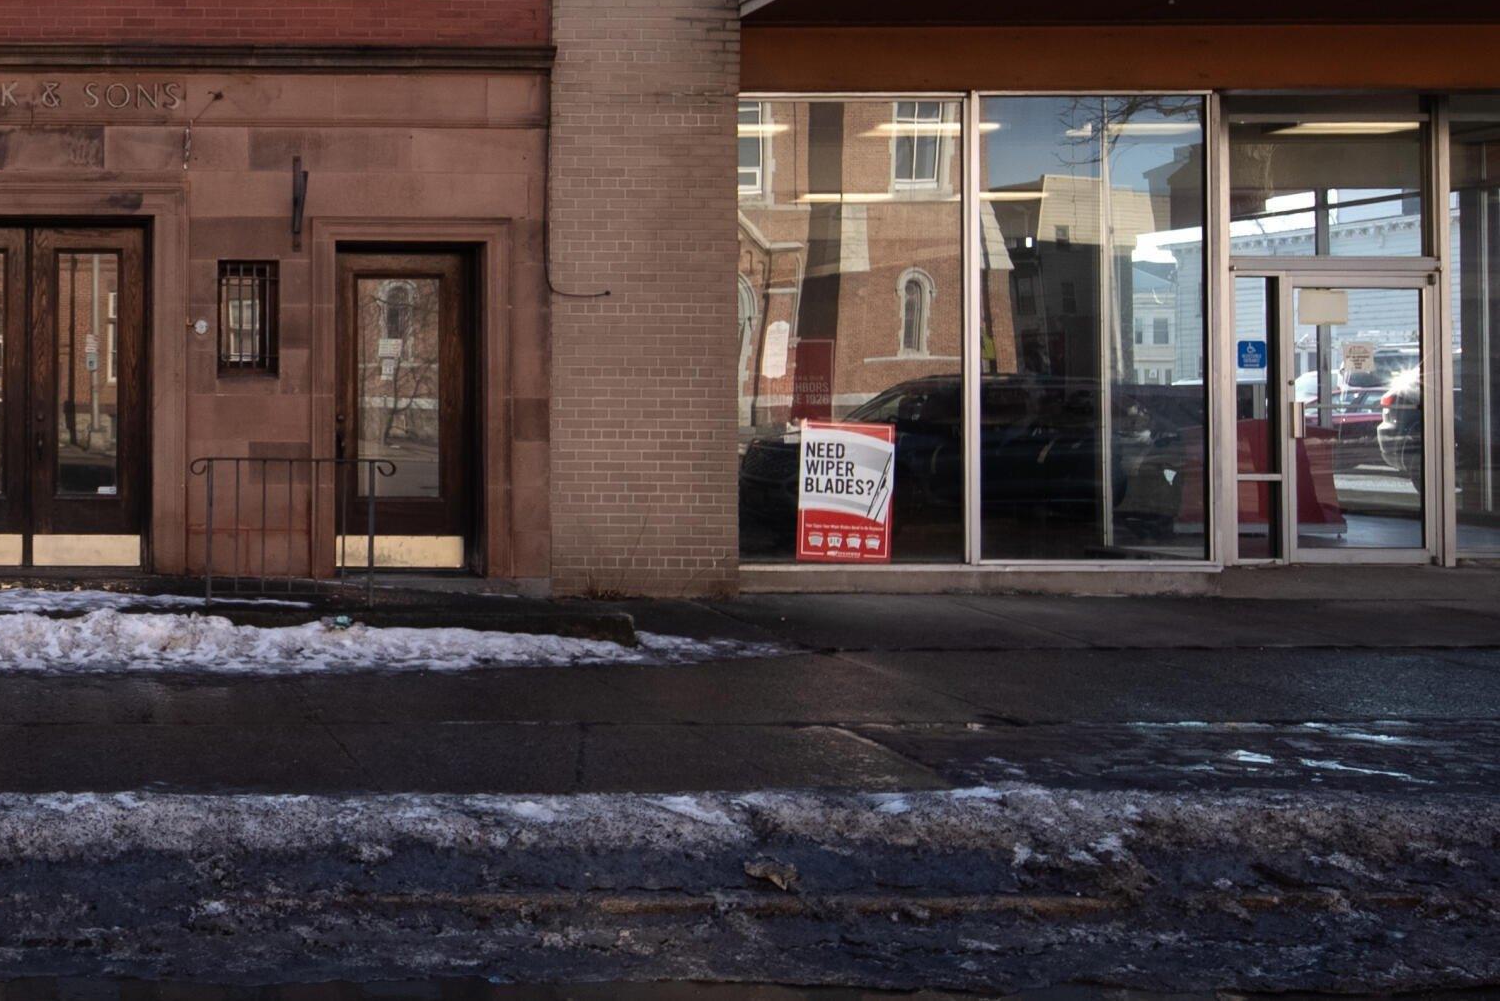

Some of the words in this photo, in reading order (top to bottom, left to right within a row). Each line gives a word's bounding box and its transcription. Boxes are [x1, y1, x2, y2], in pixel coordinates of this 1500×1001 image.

[42, 81, 61, 109] &
[84, 81, 182, 110] SONS
[806, 441, 846, 460] NEED
[806, 459, 855, 478] WIPER
[804, 477, 875, 497] BLADES?
